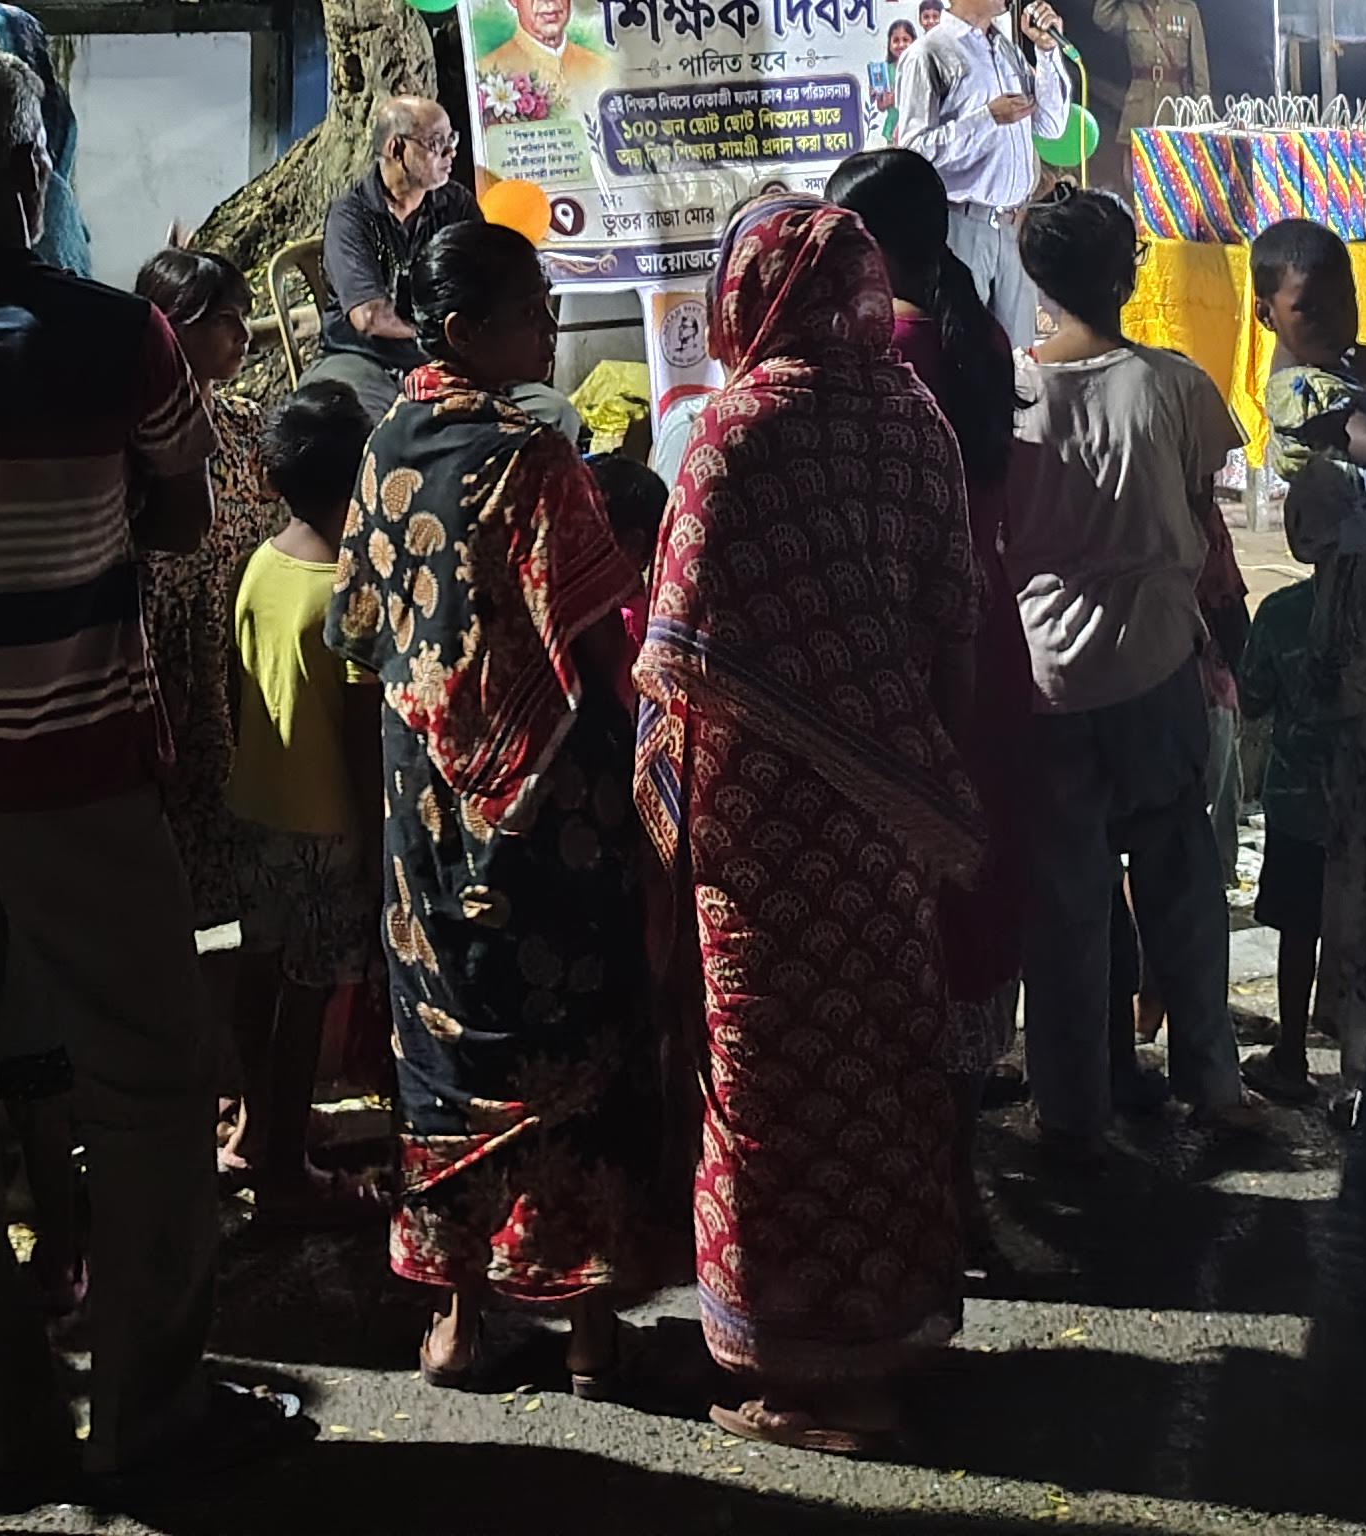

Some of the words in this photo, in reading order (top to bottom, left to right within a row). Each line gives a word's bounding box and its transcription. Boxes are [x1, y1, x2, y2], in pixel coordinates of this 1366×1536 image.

[678, 48, 742, 76] পালিত
[753, 51, 787, 73] হবে
[620, 120, 658, 142] ১০০
[659, 118, 686, 137] জন
[689, 112, 720, 135] ছোট
[724, 108, 755, 133] ছোট
[758, 107, 810, 131] শিশুদের
[811, 106, 842, 127] হাতে
[717, 133, 758, 159] সামগ্রী
[761, 136, 794, 157] প্রদান
[795, 133, 821, 153] করা
[646, 209, 680, 229] রাজা
[684, 207, 715, 226] মোর
